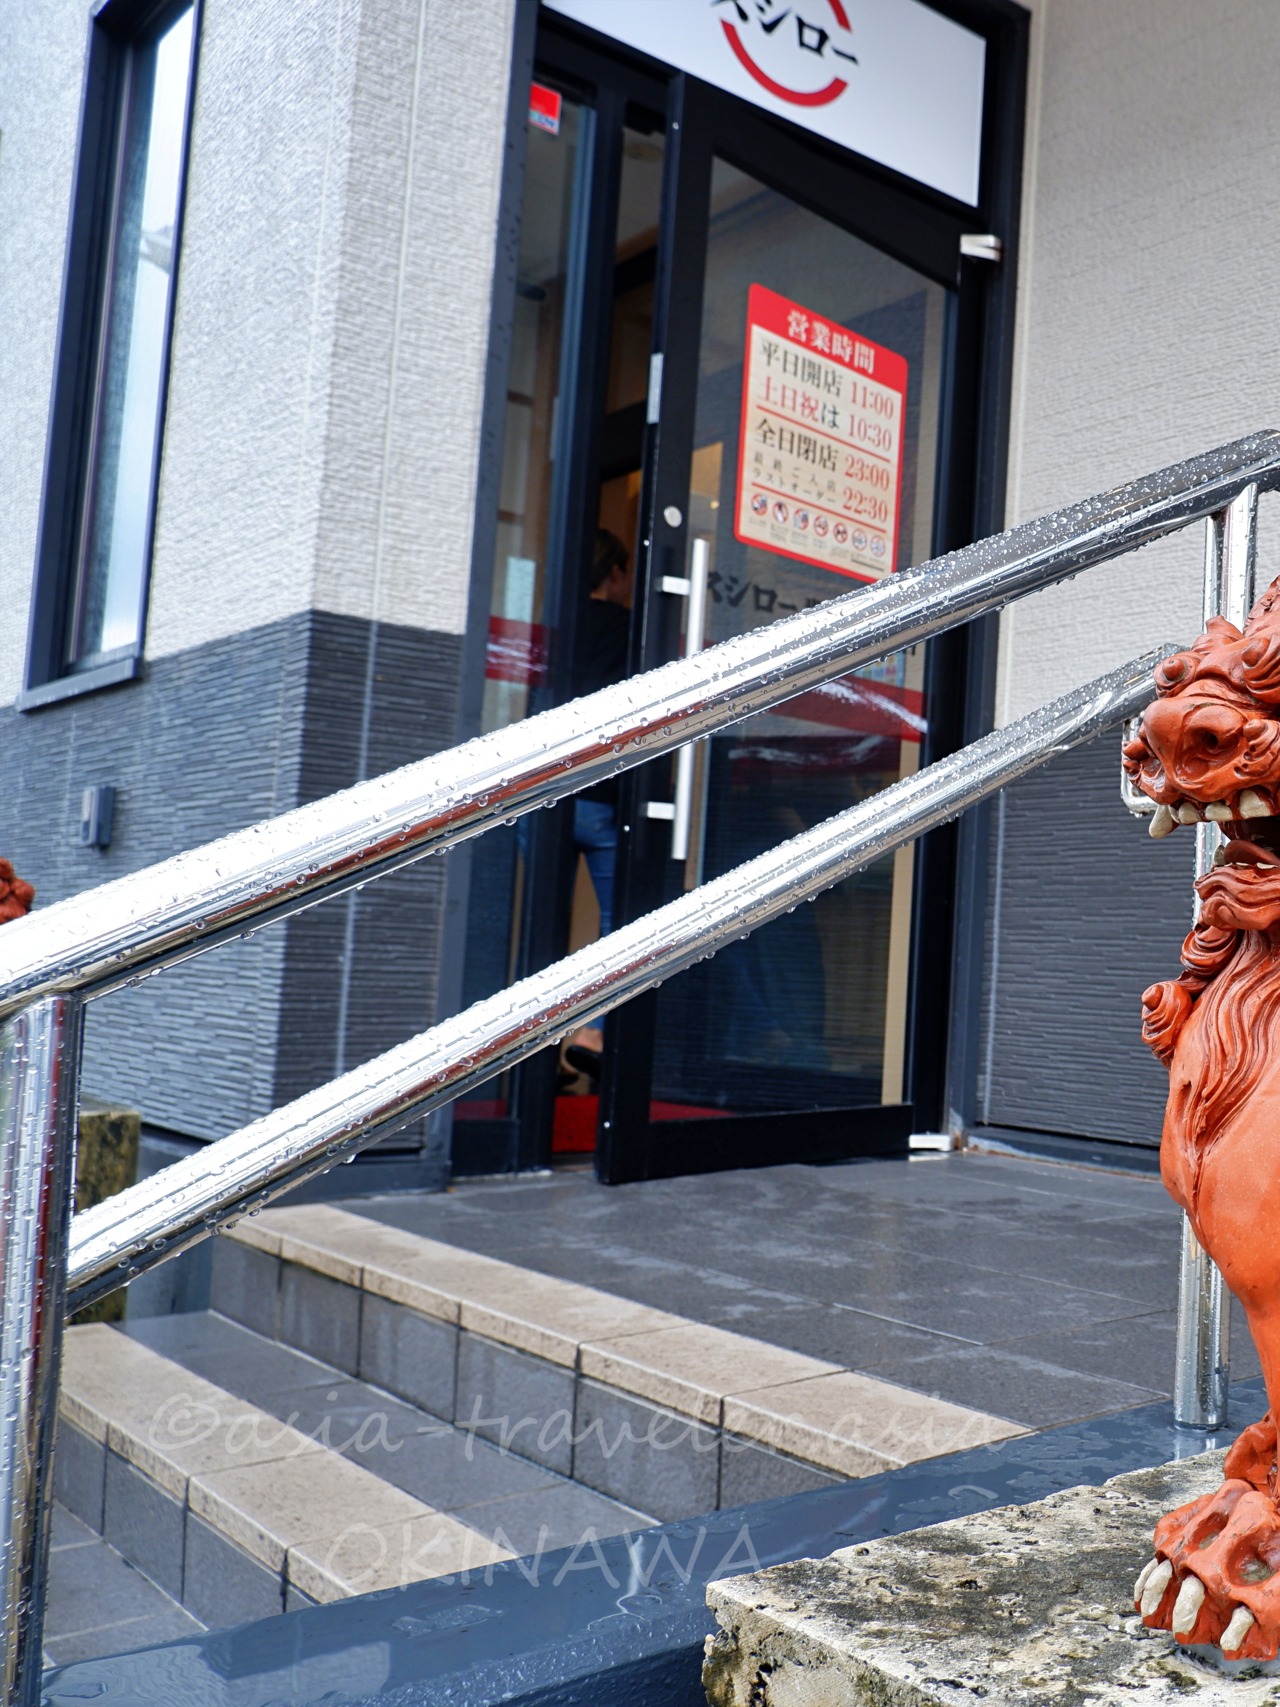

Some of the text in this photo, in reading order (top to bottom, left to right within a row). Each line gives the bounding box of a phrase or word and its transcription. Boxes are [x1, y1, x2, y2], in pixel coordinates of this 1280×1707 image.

[787, 309, 876, 375] 営業時間
[761, 341, 895, 421] 平日開店 11:00
[756, 417, 891, 492] 全日閉店 23:00
[849, 414, 893, 452] 10:30
[842, 487, 889, 524] 22:30
